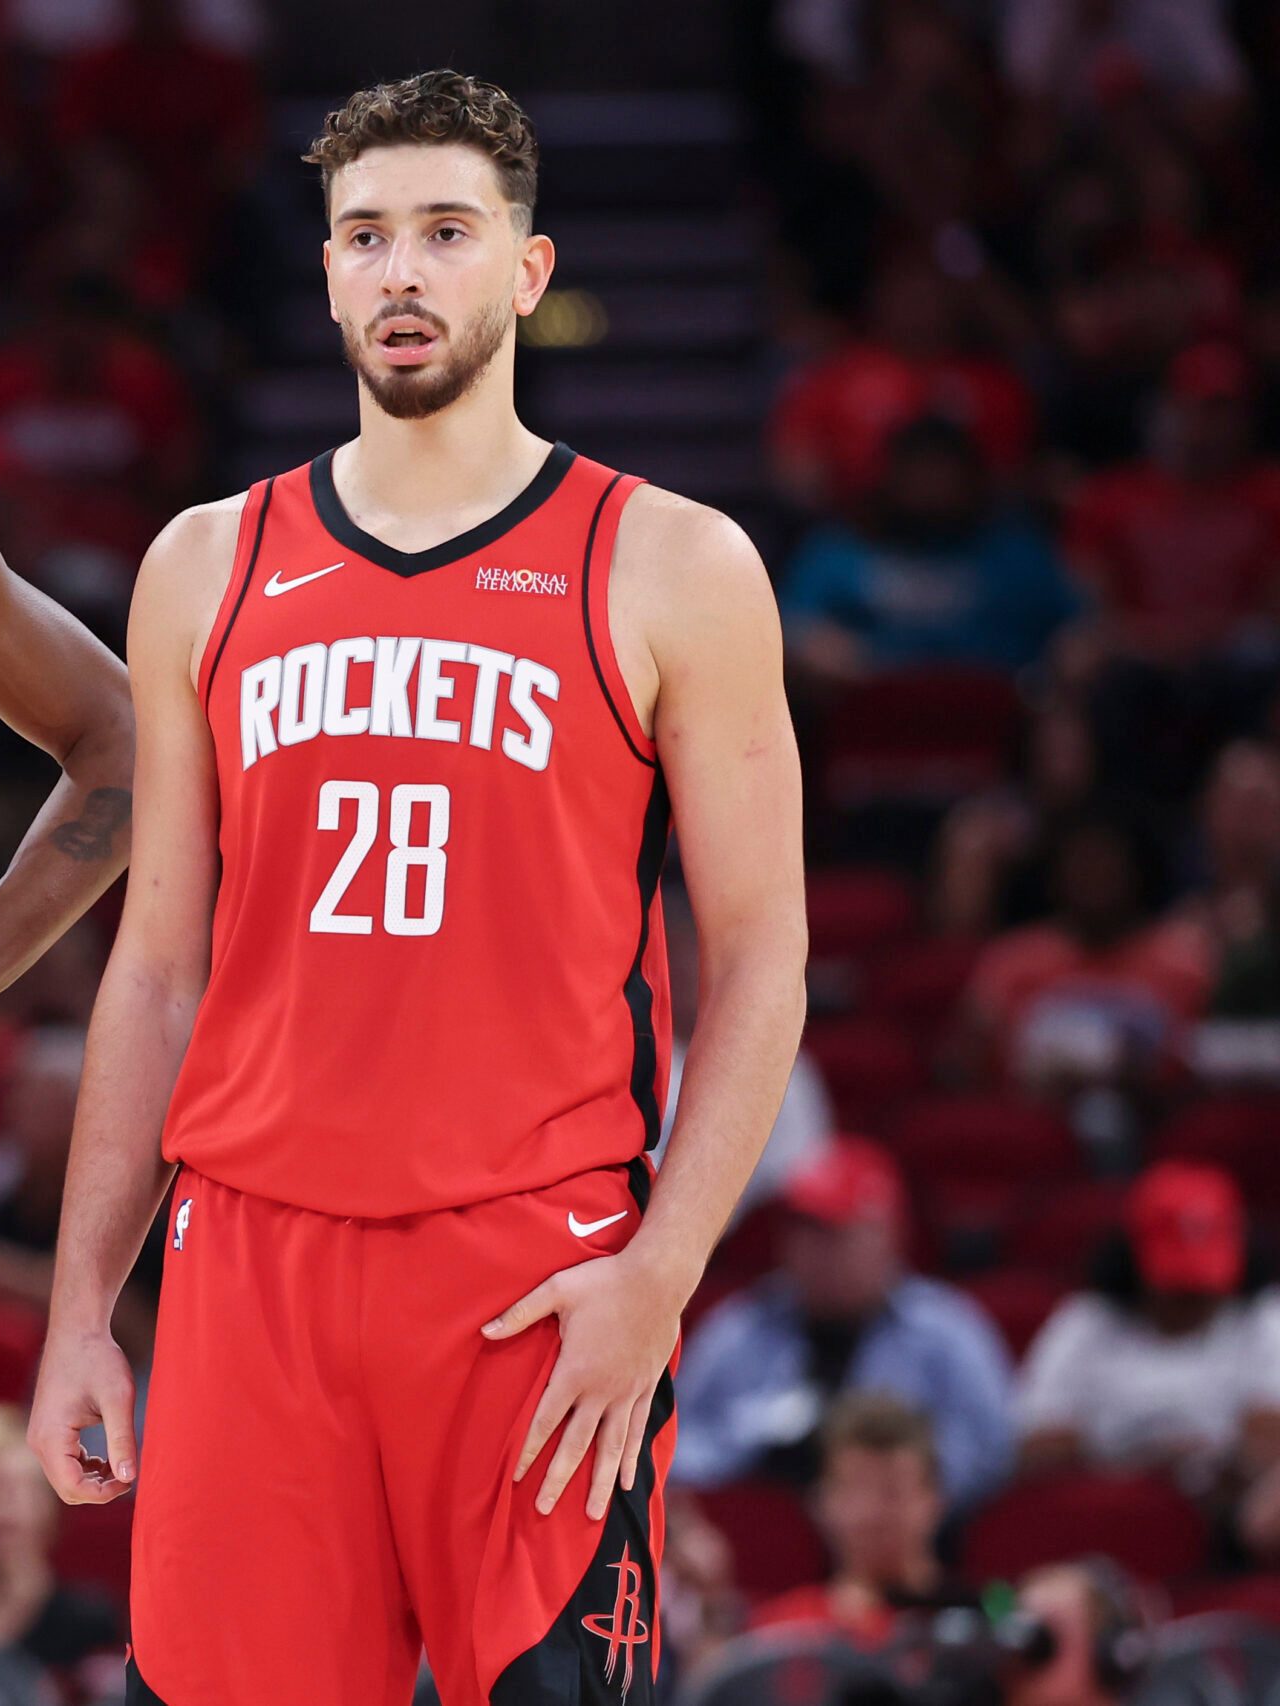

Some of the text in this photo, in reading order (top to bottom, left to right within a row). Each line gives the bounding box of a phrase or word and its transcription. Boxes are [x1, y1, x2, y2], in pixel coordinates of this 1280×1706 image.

[475, 575, 568, 596] HERMANN
[477, 566, 568, 587] MEMORIAL
[240, 636, 560, 772] ROCKETS
[309, 780, 450, 937] 28
